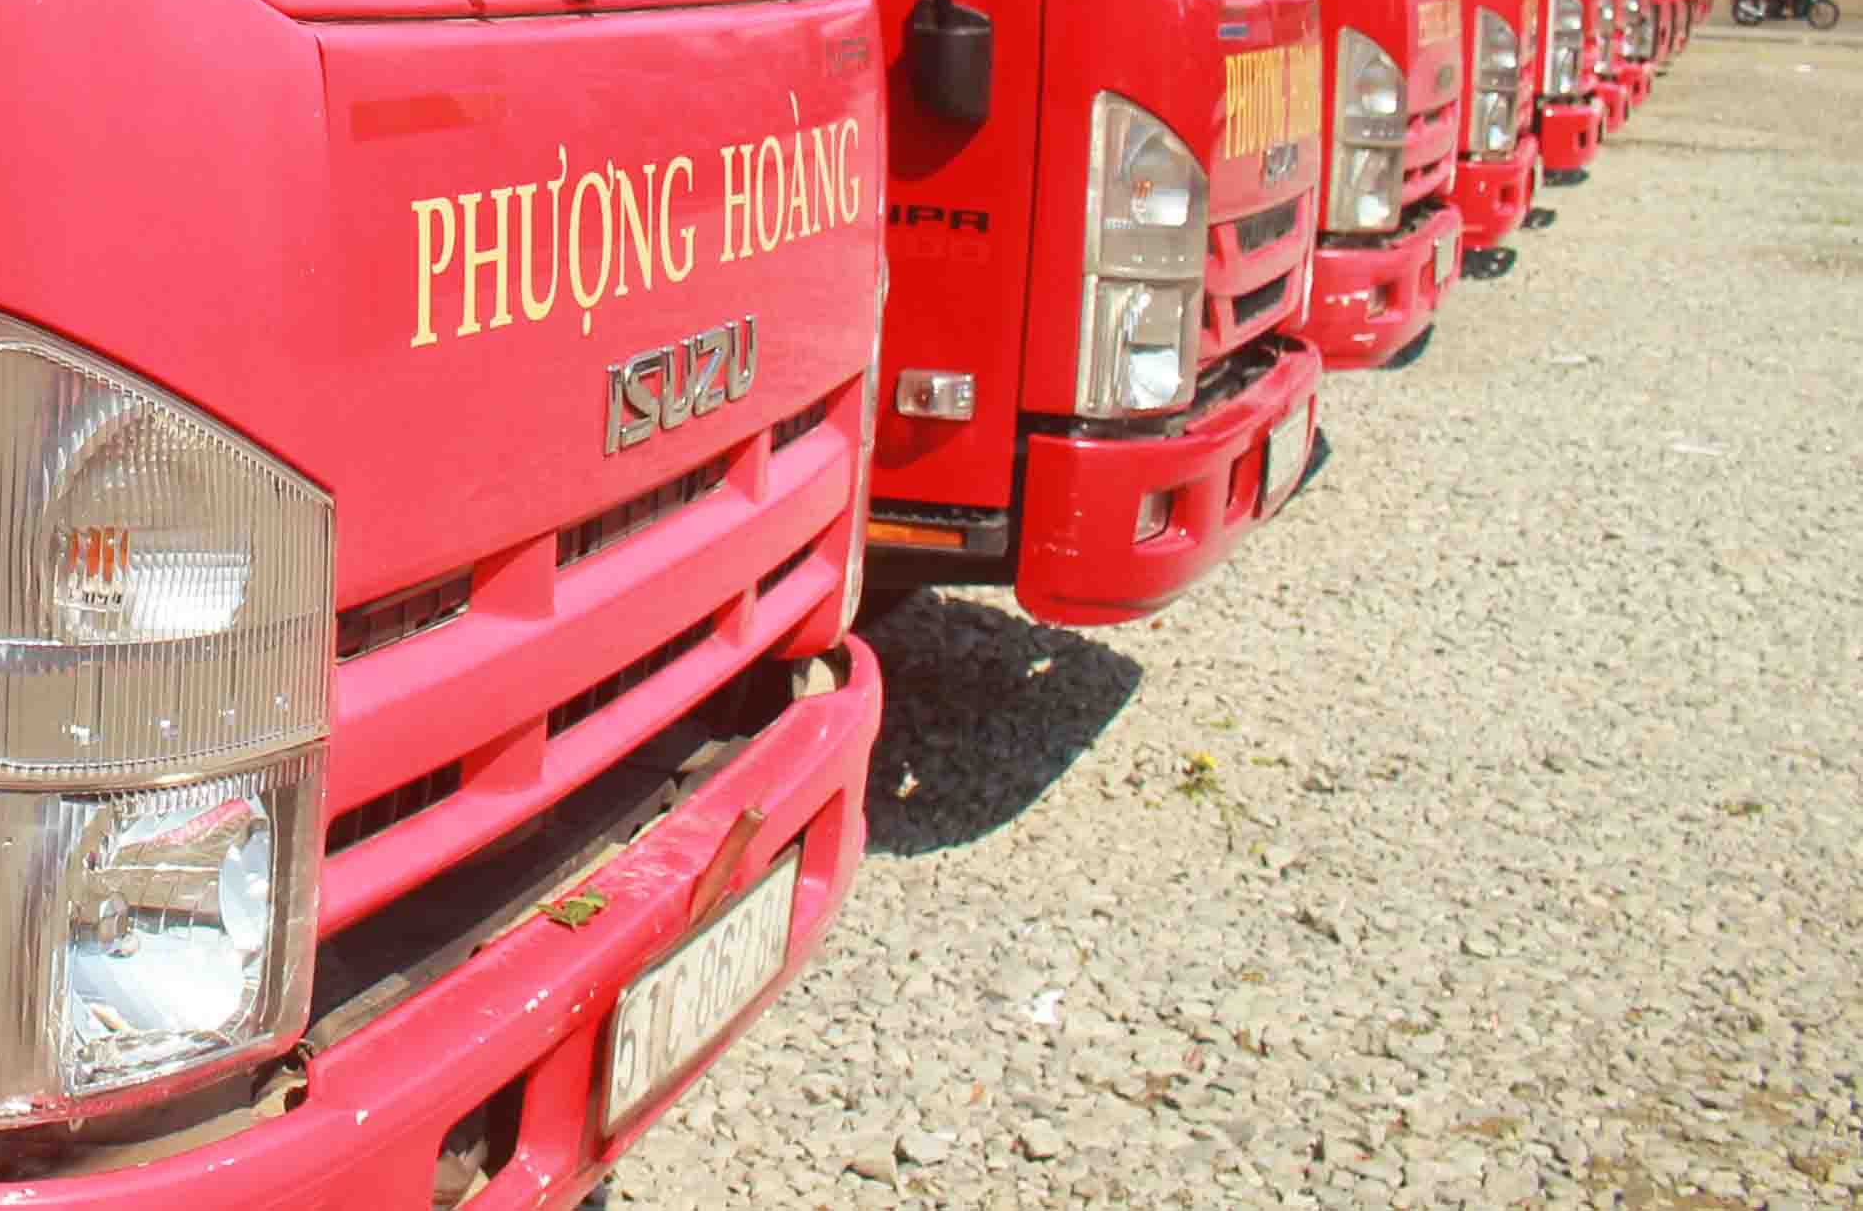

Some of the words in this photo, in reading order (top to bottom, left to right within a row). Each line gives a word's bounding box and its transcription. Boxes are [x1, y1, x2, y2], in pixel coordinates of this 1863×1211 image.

[410, 143, 696, 348] PHƯỢNG
[719, 91, 860, 263] HOÀNG
[603, 314, 758, 455] ISUZU
